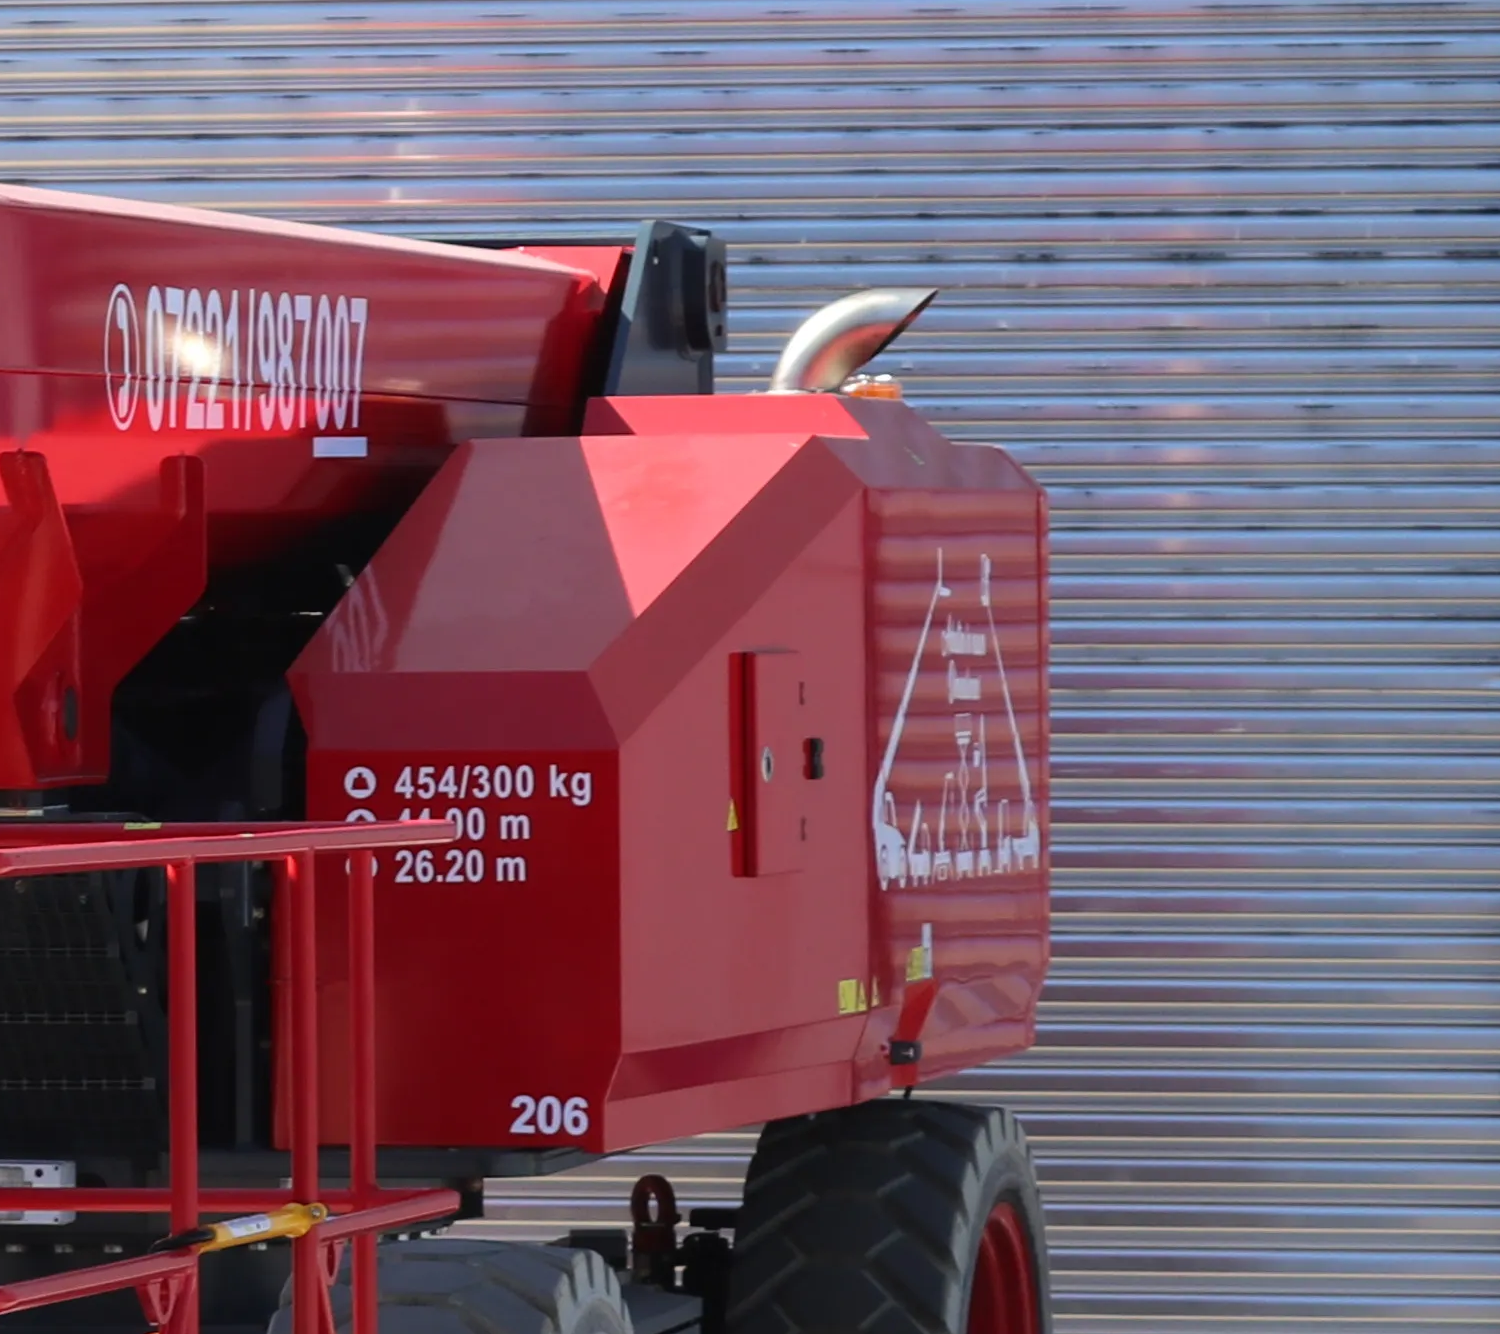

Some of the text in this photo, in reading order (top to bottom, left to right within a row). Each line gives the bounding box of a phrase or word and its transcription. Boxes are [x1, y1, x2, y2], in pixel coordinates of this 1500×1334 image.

[145, 284, 368, 432] 07221/987007
[393, 764, 593, 807] 454/300 kg
[499, 813, 531, 841] m
[393, 849, 527, 884] 26.20 m
[509, 1095, 590, 1137] 206
